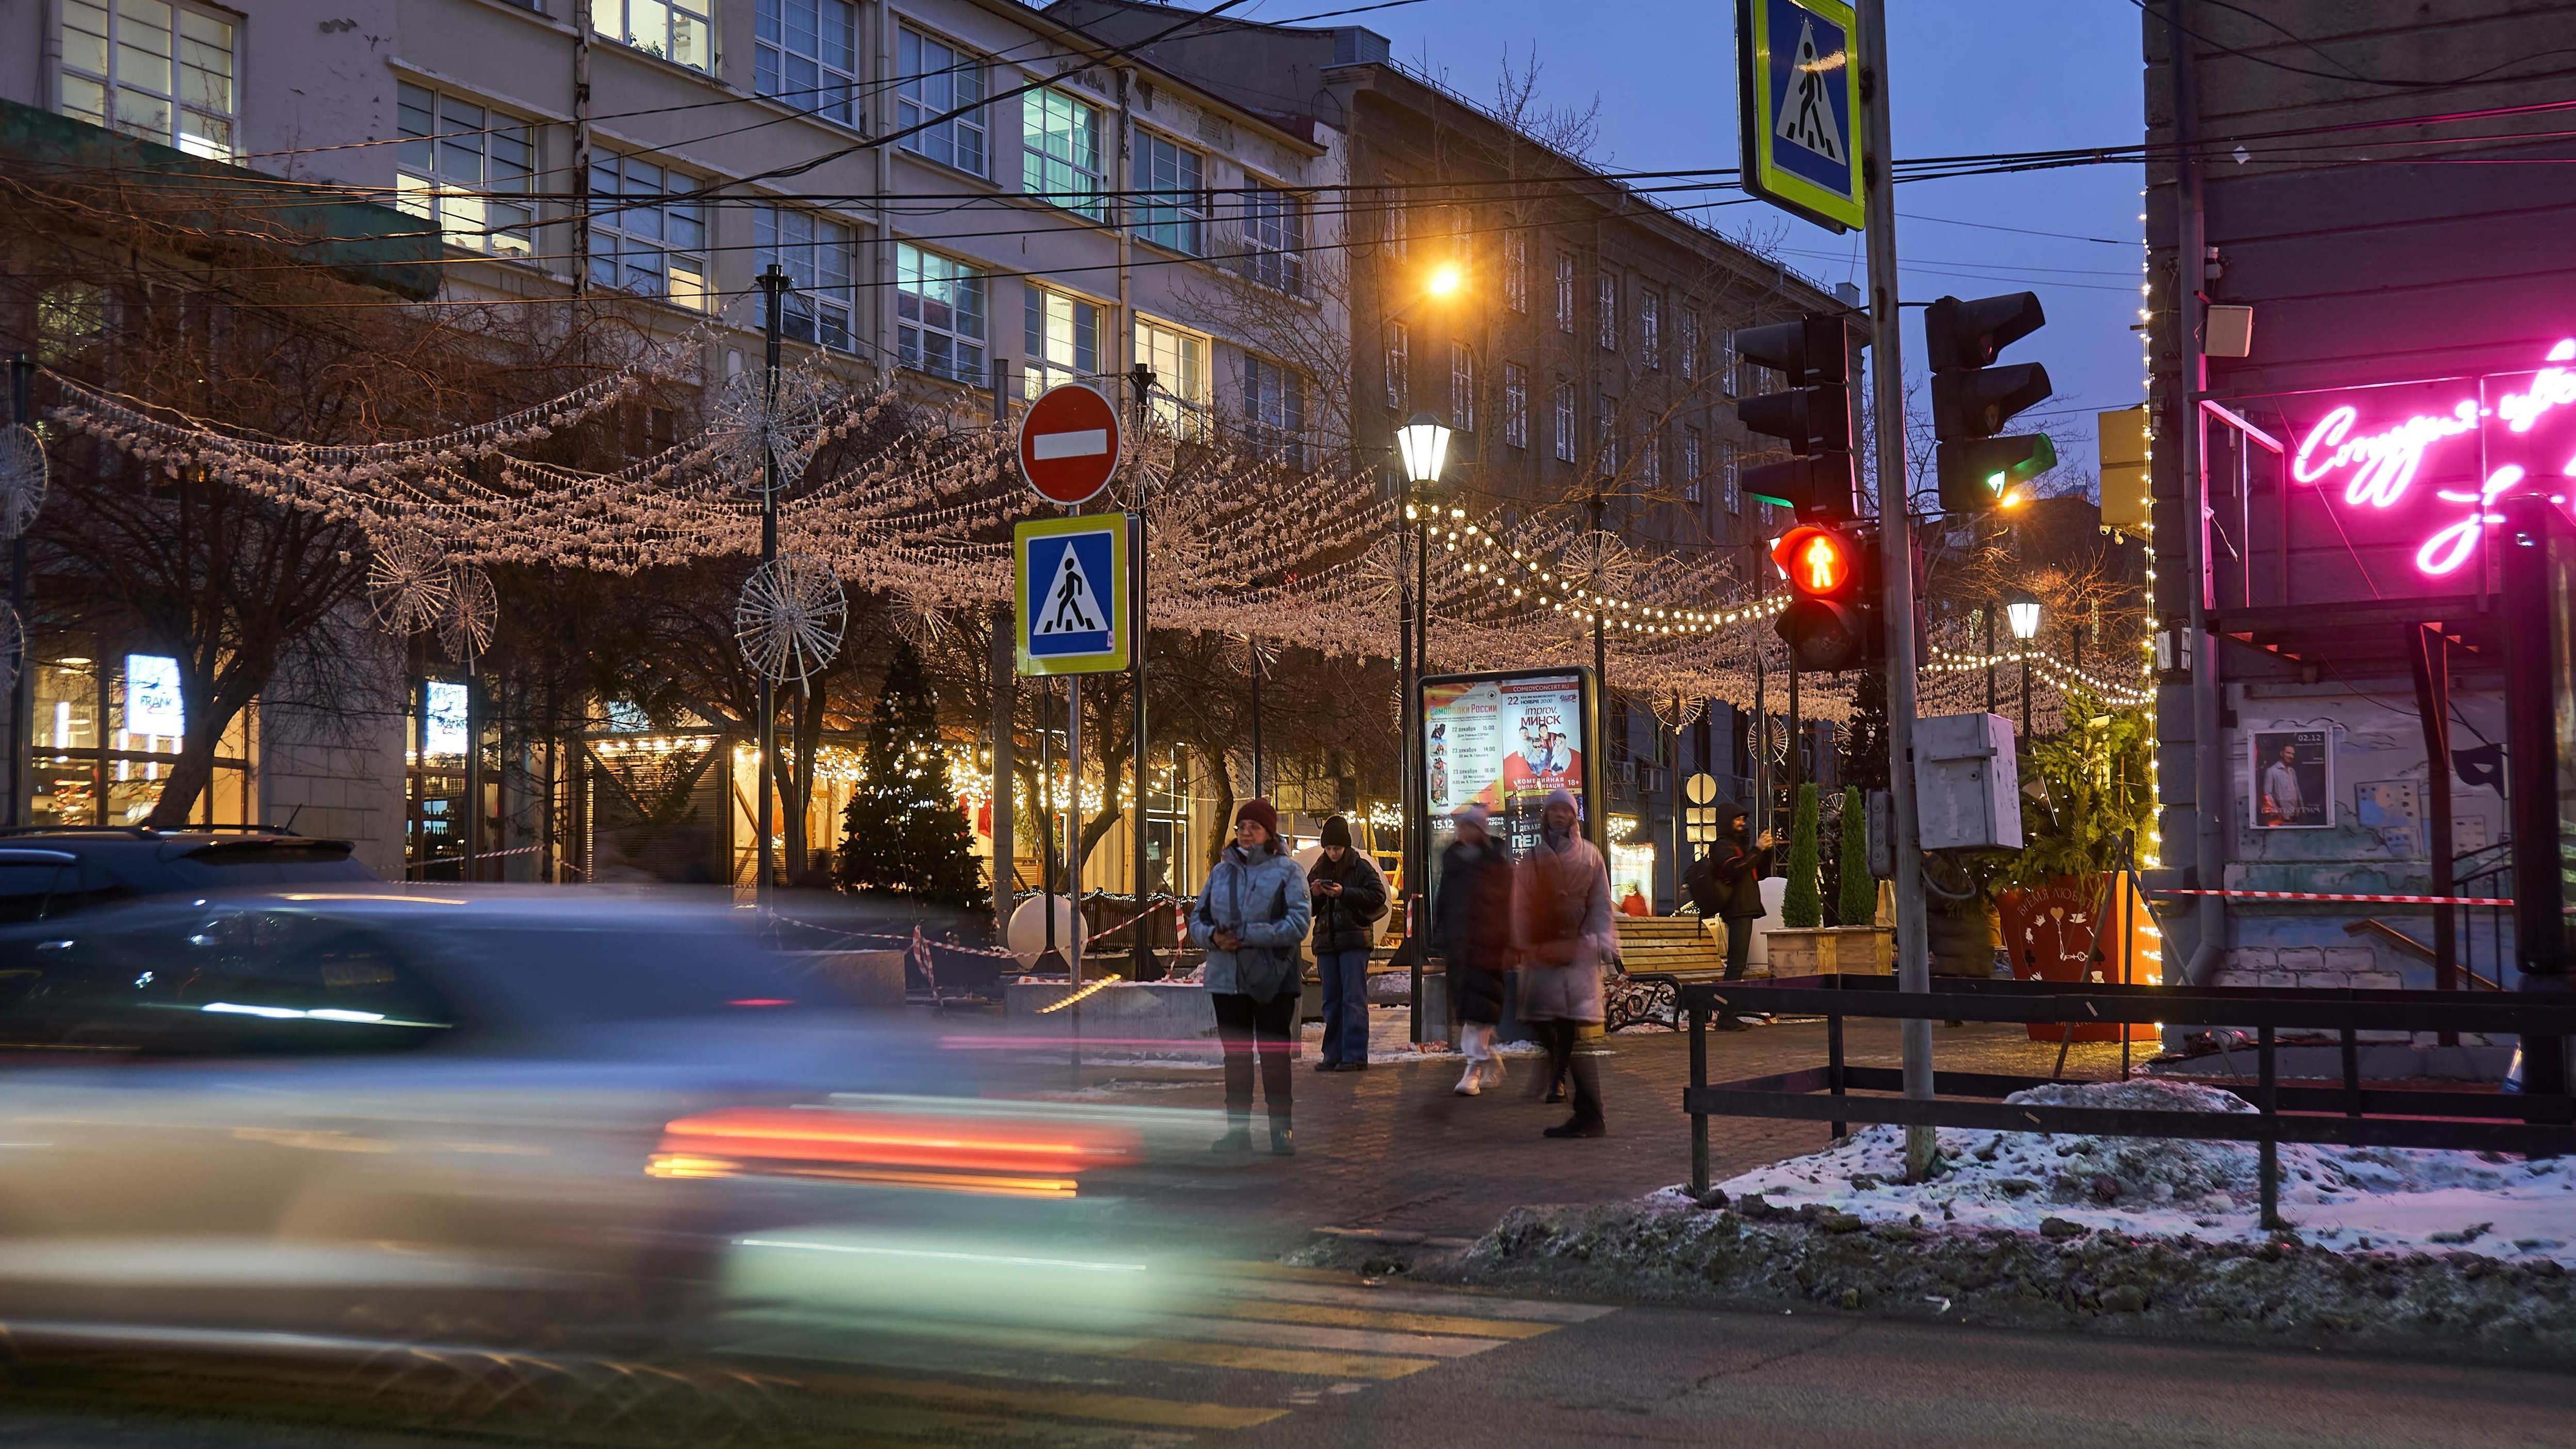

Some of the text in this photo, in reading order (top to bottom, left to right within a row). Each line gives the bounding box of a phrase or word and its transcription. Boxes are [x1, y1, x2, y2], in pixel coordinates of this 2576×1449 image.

[140, 695, 173, 707] FRANK
[1507, 697, 1519, 705] 22
[1430, 703, 1498, 716] Самородки России
[1525, 705, 1557, 716] improv.
[1521, 715, 1561, 727] МИНСК
[1432, 819, 1455, 830] 15.12
[1511, 820, 1517, 832] 1
